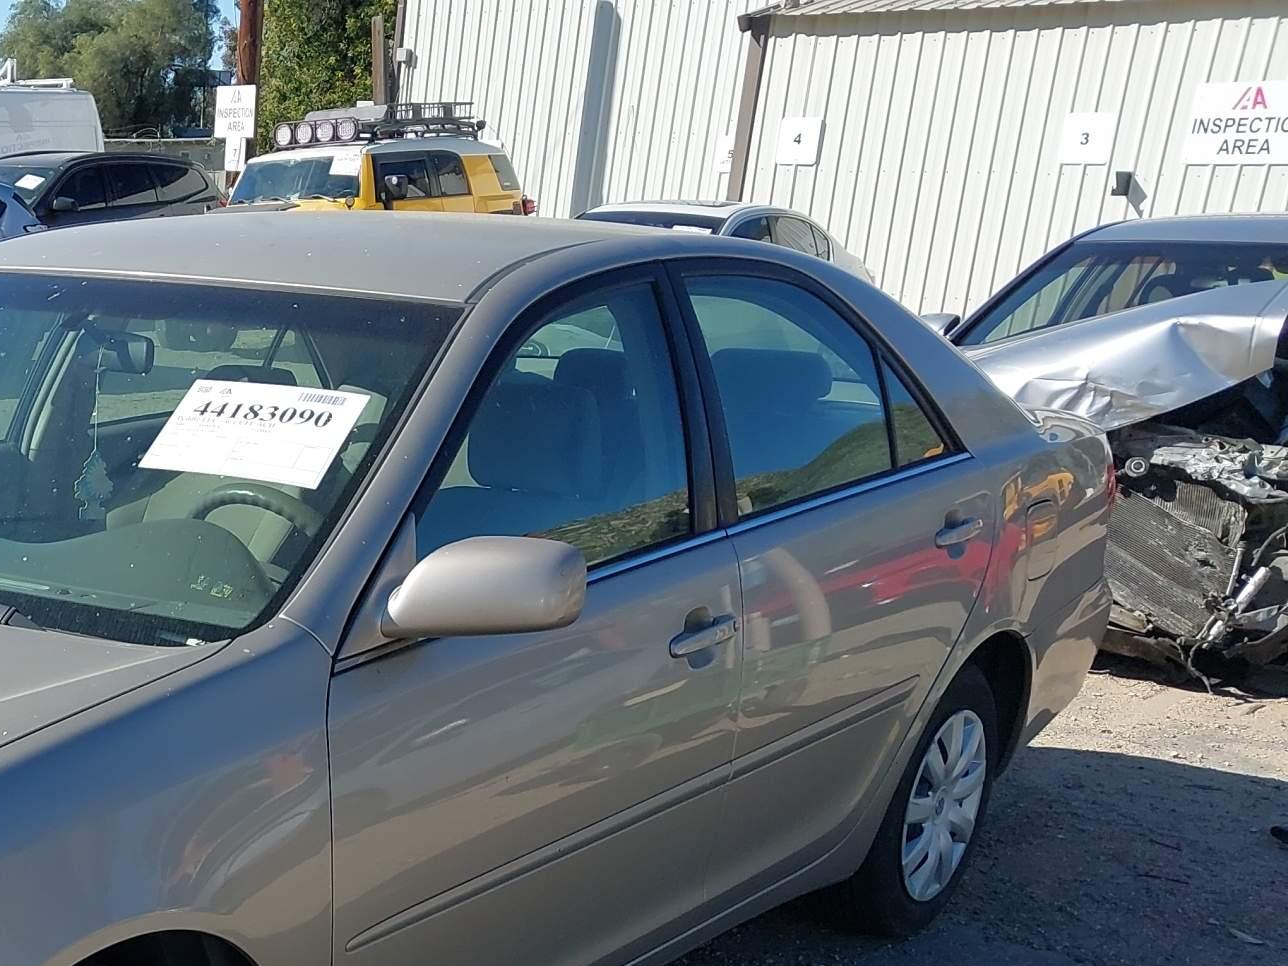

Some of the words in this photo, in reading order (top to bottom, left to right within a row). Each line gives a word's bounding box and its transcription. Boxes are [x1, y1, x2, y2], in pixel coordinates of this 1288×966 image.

[216, 107, 254, 119] INSPECTION
[226, 121, 245, 132] AREA
[793, 132, 802, 145] 4
[1080, 132, 1090, 146] 3
[1216, 138, 1271, 155] AREA
[193, 400, 333, 428] 44183090
